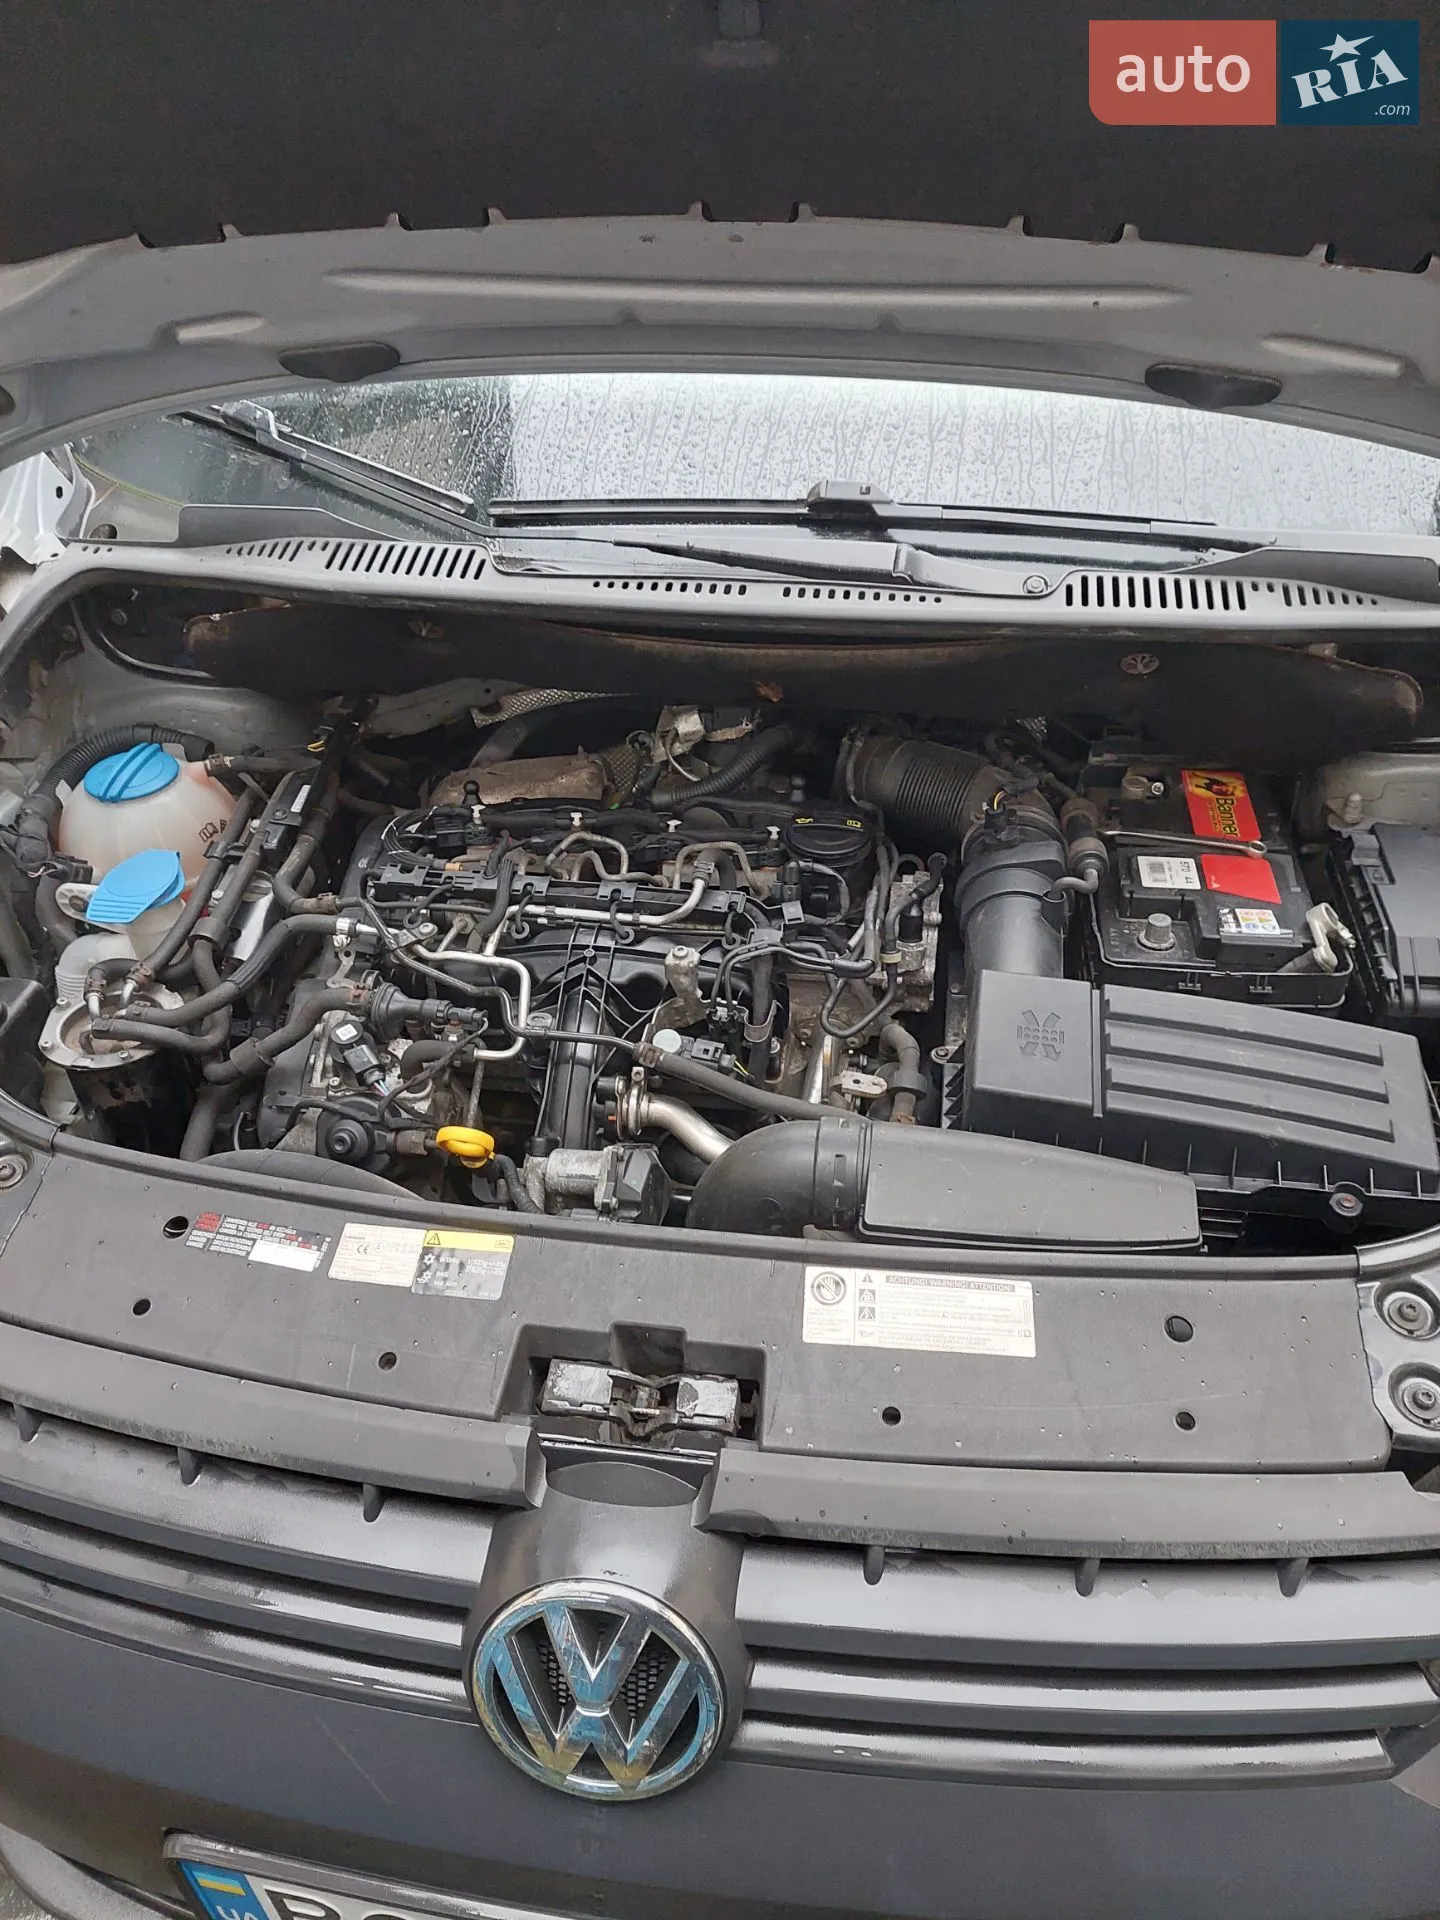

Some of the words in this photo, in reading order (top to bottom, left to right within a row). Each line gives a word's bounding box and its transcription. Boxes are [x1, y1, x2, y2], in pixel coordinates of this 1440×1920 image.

[1215, 797, 1241, 838] Banner
[888, 1275, 928, 1286] ACHTUNG!
[928, 1279, 968, 1289] WARNING!
[969, 1283, 1014, 1293] ATTENTION!
